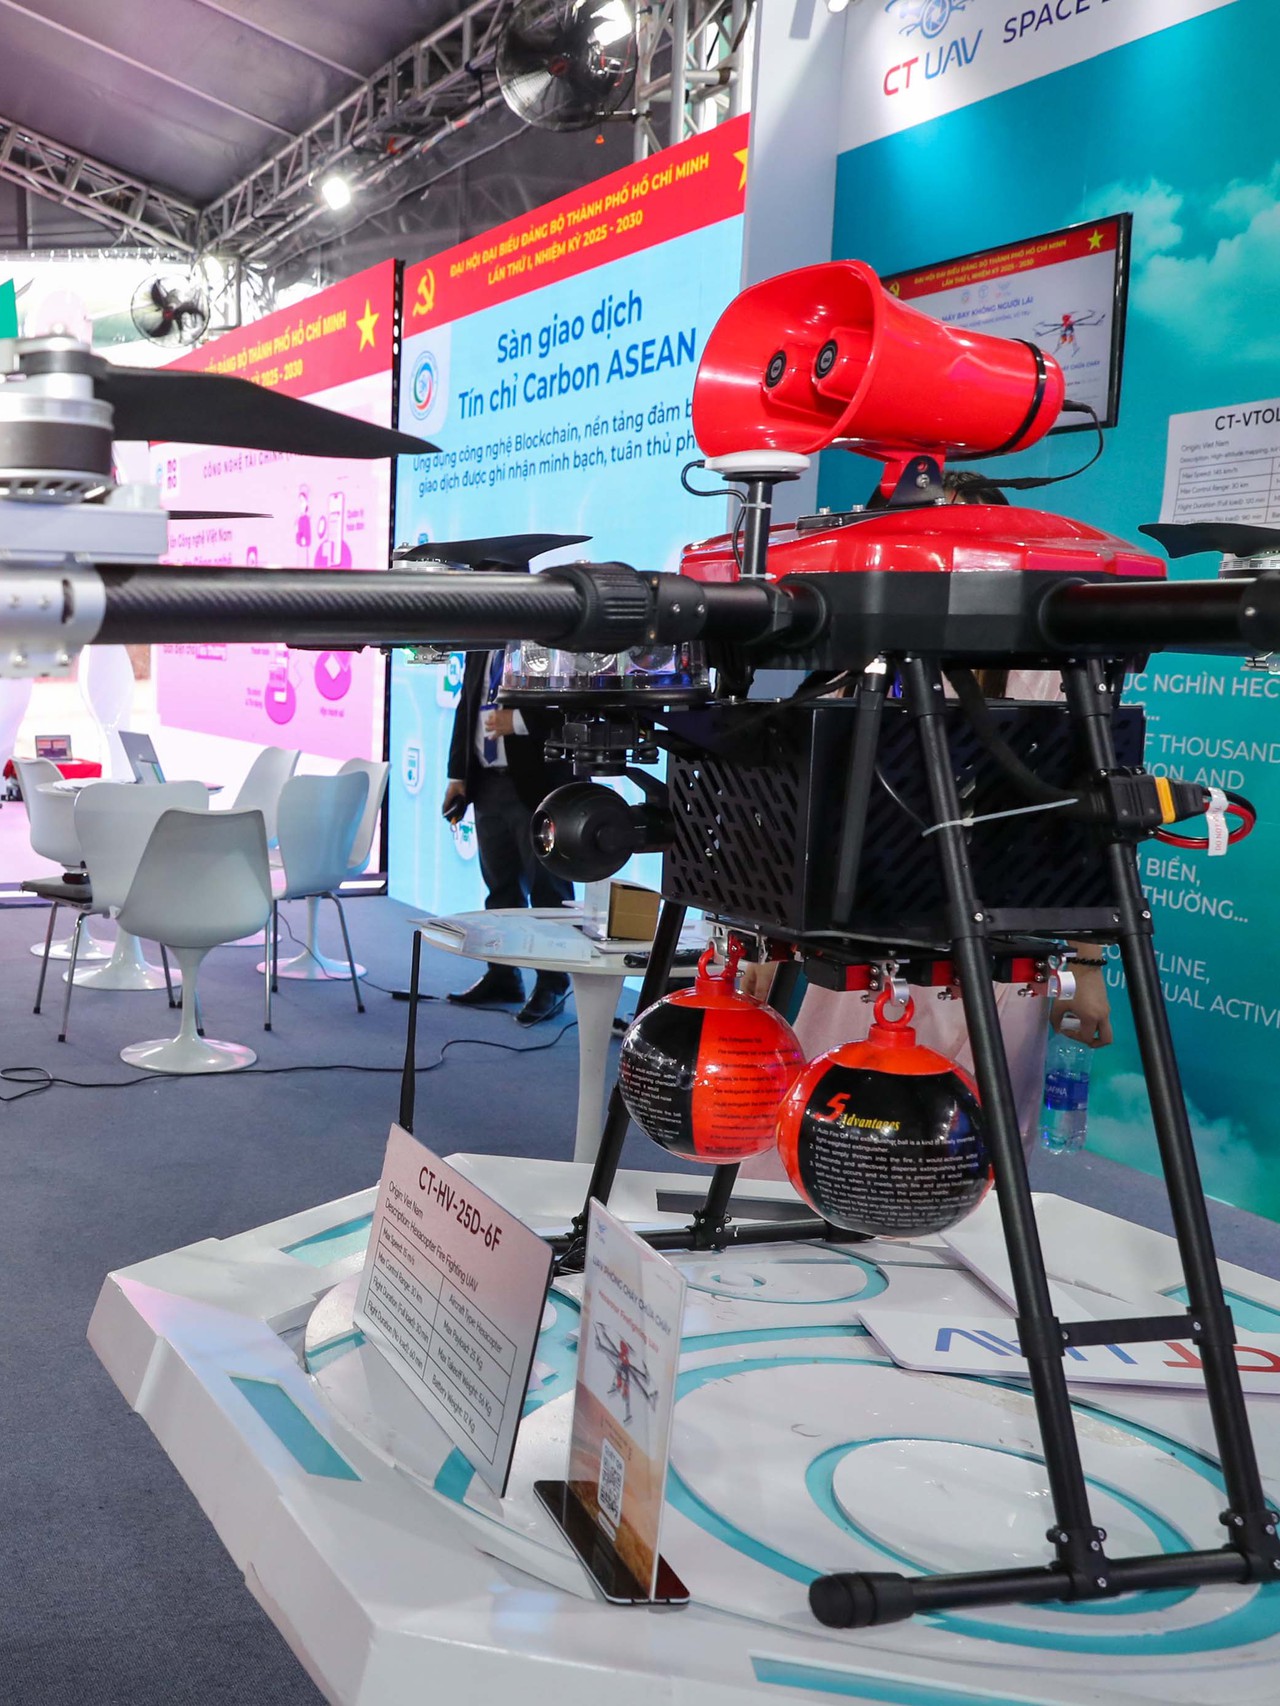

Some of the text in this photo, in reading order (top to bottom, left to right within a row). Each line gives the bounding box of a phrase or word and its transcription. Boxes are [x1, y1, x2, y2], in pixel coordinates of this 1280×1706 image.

[1003, 0, 1090, 43] SPACE
[883, 29, 983, 96] CT UAV
[450, 261, 464, 278] ĐẠI
[466, 251, 481, 271] HỘI
[482, 246, 498, 263] ĐẠI
[521, 224, 548, 247] ĐẢNG
[550, 213, 565, 234] BỘ
[567, 199, 603, 227] THÀNH
[605, 181, 629, 211] PHỐ
[631, 173, 649, 199] HỒ
[652, 163, 673, 190] CHÍ
[675, 152, 709, 181] MINH
[488, 265, 506, 285] LẦN
[507, 255, 526, 277] THỨ
[534, 241, 566, 266] NHIỆM
[568, 232, 581, 252] KỲ
[583, 224, 607, 247] 2025
[616, 209, 643, 234] 2030
[273, 326, 290, 355] PHỐ
[306, 315, 322, 342] CHÍ
[323, 310, 347, 335] MINH
[497, 290, 642, 363] Sàn giao dịch
[284, 359, 303, 381] 2030
[458, 327, 697, 419] Tín chỉ Carbon ASEAN
[433, 452, 456, 470] dụng
[459, 445, 483, 463] công
[485, 436, 512, 460] nghệ
[514, 422, 581, 452] Blockchain,
[584, 415, 609, 438] nền
[612, 410, 644, 433] tảng
[647, 401, 680, 426] đảm
[419, 477, 438, 498] giao
[440, 471, 460, 493] dịch
[462, 470, 487, 489] được
[488, 463, 506, 487] ghi
[508, 460, 536, 481] nhận
[539, 452, 570, 474] minh
[573, 446, 607, 472] bạch,
[611, 440, 642, 463] tuân
[646, 431, 671, 456] thủ
[1153, 670, 1226, 696] NGHÌN
[1159, 733, 1280, 764] THOUSAND
[1193, 767, 1245, 790] AND
[1146, 855, 1201, 887] BIỂN,
[813, 1092, 852, 1122] 5
[389, 1181, 424, 1218] Origin: Viet Nam
[418, 1166, 502, 1251] CT-HV-25D-6F
[383, 1228, 391, 1241] Max
[385, 1198, 478, 1293] Description: Hexacopter Fire Fighting UAV
[379, 1252, 387, 1265] Max
[386, 1259, 400, 1278] Control
[383, 1286, 398, 1308] Duration
[443, 1320, 453, 1335] Max
[470, 1348, 477, 1361] 25
[475, 1355, 484, 1371] Kg
[476, 1321, 503, 1356] Hexacopter
[438, 1348, 448, 1363] Max
[484, 1399, 493, 1417] Kg
